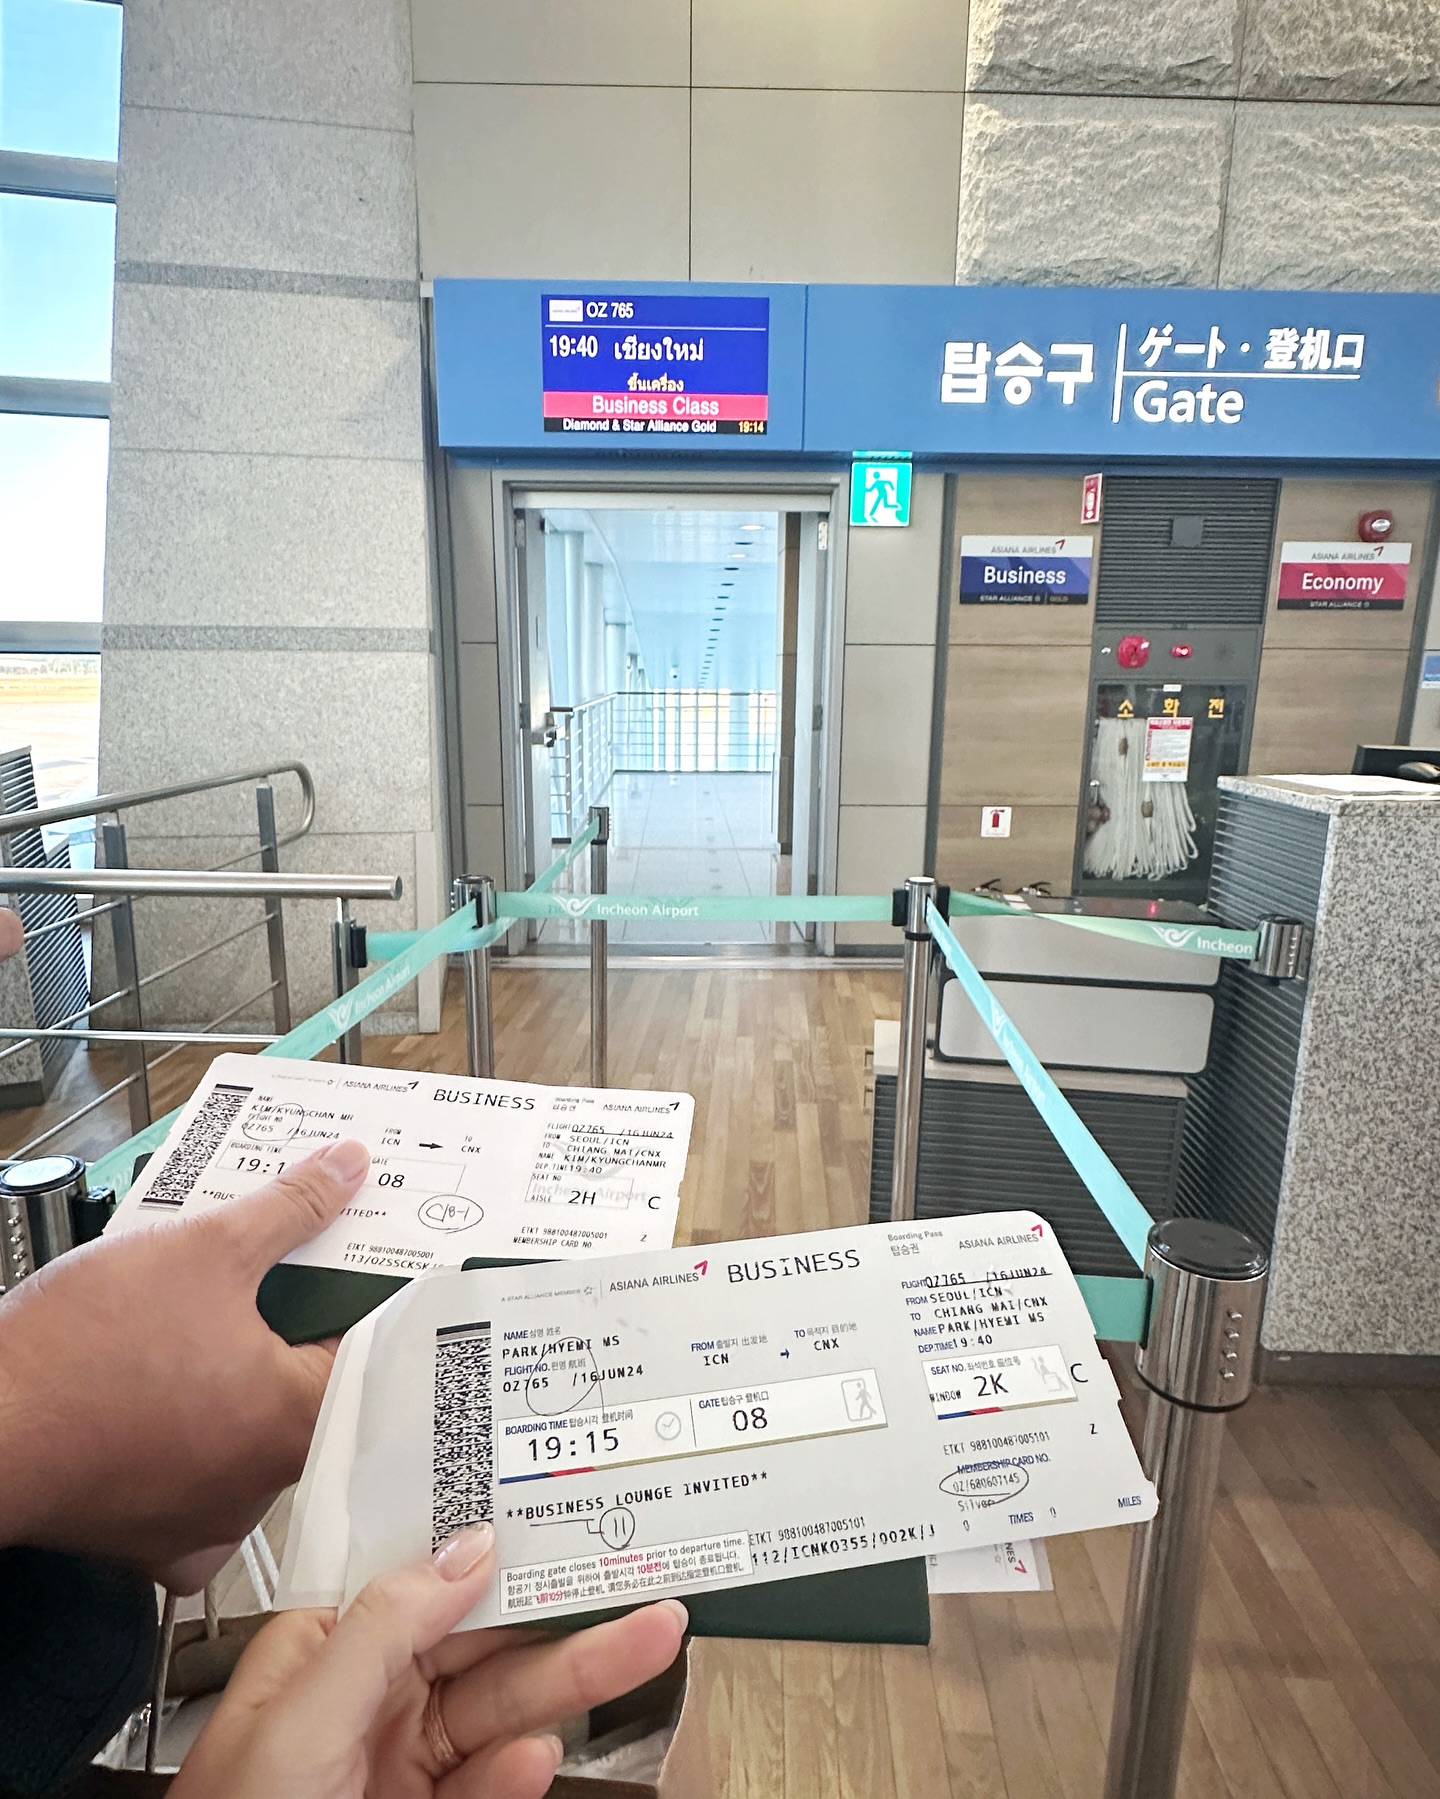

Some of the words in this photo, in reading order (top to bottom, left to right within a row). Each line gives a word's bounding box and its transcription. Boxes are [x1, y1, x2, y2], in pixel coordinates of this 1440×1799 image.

[586, 302, 608, 318] OZ
[611, 302, 634, 318] 765
[549, 335, 598, 357] 19:40
[940, 341, 1095, 405] 탑승구
[592, 395, 667, 415] Business
[673, 396, 719, 415] Class
[1132, 380, 1245, 424] Gate
[563, 418, 609, 431] Diamond
[612, 419, 619, 431] &
[622, 419, 645, 432] Star
[647, 420, 689, 432] Alliance
[691, 420, 717, 433] Gold
[738, 421, 764, 433] 19:14
[991, 545, 1019, 554] ASIANA
[1022, 545, 1056, 554] AIRLINES
[1312, 552, 1339, 560] ASIANA
[1341, 553, 1375, 561] AIRLINES
[984, 566, 1066, 584] Business
[1302, 573, 1384, 594] Economy
[597, 904, 648, 916] Incheon
[652, 904, 698, 918] Airport
[1197, 937, 1253, 954] Incheon
[343, 1080, 371, 1089] ASIANA
[374, 1083, 408, 1093] AIRLINES
[433, 1088, 536, 1111] BUSINESS
[603, 1104, 632, 1112] ASIANA
[634, 1105, 670, 1114] AIRLINES
[381, 1137, 401, 1146] ICN
[570, 1136, 629, 1145] SEOUL/ICN
[461, 1145, 481, 1154] CNX
[567, 1145, 607, 1154] CHIANG
[614, 1148, 661, 1157] MAI/CNX
[236, 1157, 286, 1174] 19:1
[371, 1157, 388, 1165] GATE
[570, 1165, 602, 1174] 19:40
[378, 1172, 405, 1188] 08
[568, 1190, 596, 1205] 2H
[648, 1196, 661, 1209] C
[513, 1237, 557, 1246] MEMBERSHIP
[561, 1239, 579, 1247] CARD
[888, 1231, 922, 1241] Boarding
[923, 1230, 943, 1239] Pass
[959, 1236, 995, 1249] ASIANA
[997, 1233, 1039, 1245] AIRLINES
[347, 1242, 366, 1251] ETKT
[890, 1243, 921, 1256] 탑승권
[728, 1249, 860, 1283] BUSINESS
[609, 1278, 649, 1292] ASIANA
[652, 1272, 699, 1286] AIRLINES
[901, 1279, 926, 1289] FLIGHT
[524, 1292, 553, 1300] ALLIANCE
[905, 1295, 929, 1305] FROM
[929, 1286, 1003, 1304] SEOUL/ICN
[910, 1312, 921, 1321] TO
[934, 1304, 984, 1319] CHIANG
[991, 1296, 1048, 1313] MAI/CNX
[913, 1326, 937, 1337] NAME
[938, 1315, 1020, 1334] PARK/HYEMI
[1028, 1312, 1045, 1323] MS
[504, 1330, 528, 1340] NAME
[794, 1329, 806, 1338] TO
[502, 1339, 592, 1359] PARK/HYEMI
[602, 1335, 620, 1347] MS
[691, 1341, 715, 1352] FROM
[813, 1338, 840, 1351] CNX
[953, 1334, 993, 1349] 19:40
[703, 1353, 729, 1366] ICN
[504, 1364, 534, 1376] FLIGHT
[930, 1364, 950, 1375] SEAT
[951, 1363, 966, 1372] NO.
[1070, 1363, 1089, 1383] C
[502, 1377, 549, 1392] OZ765
[573, 1364, 643, 1386] /16JUN24
[973, 1373, 1009, 1397] 2K
[929, 1389, 962, 1402] WINDOW
[699, 1398, 720, 1409] GATE
[732, 1407, 769, 1431] 08
[505, 1422, 547, 1436] BOARDING
[548, 1420, 568, 1430] TIME
[528, 1427, 619, 1461] 19:15
[943, 1442, 965, 1455] ETKT
[957, 1458, 1011, 1474] MEMBERSHIP
[1012, 1455, 1035, 1466] CARD
[1035, 1453, 1051, 1463] NO.
[615, 1485, 673, 1506] LOUNGE
[958, 1499, 996, 1512] Silver
[1008, 1512, 1034, 1525] TIMES
[1117, 1495, 1142, 1508] MILES
[749, 1531, 772, 1545] ETKT
[507, 1568, 546, 1582] Boarding
[547, 1565, 567, 1578] gate
[568, 1560, 597, 1573] closes
[599, 1552, 644, 1568] 10minutes
[646, 1549, 666, 1561] prior
[669, 1547, 678, 1556] to
[680, 1541, 721, 1557] departure
[723, 1537, 745, 1550] time.
